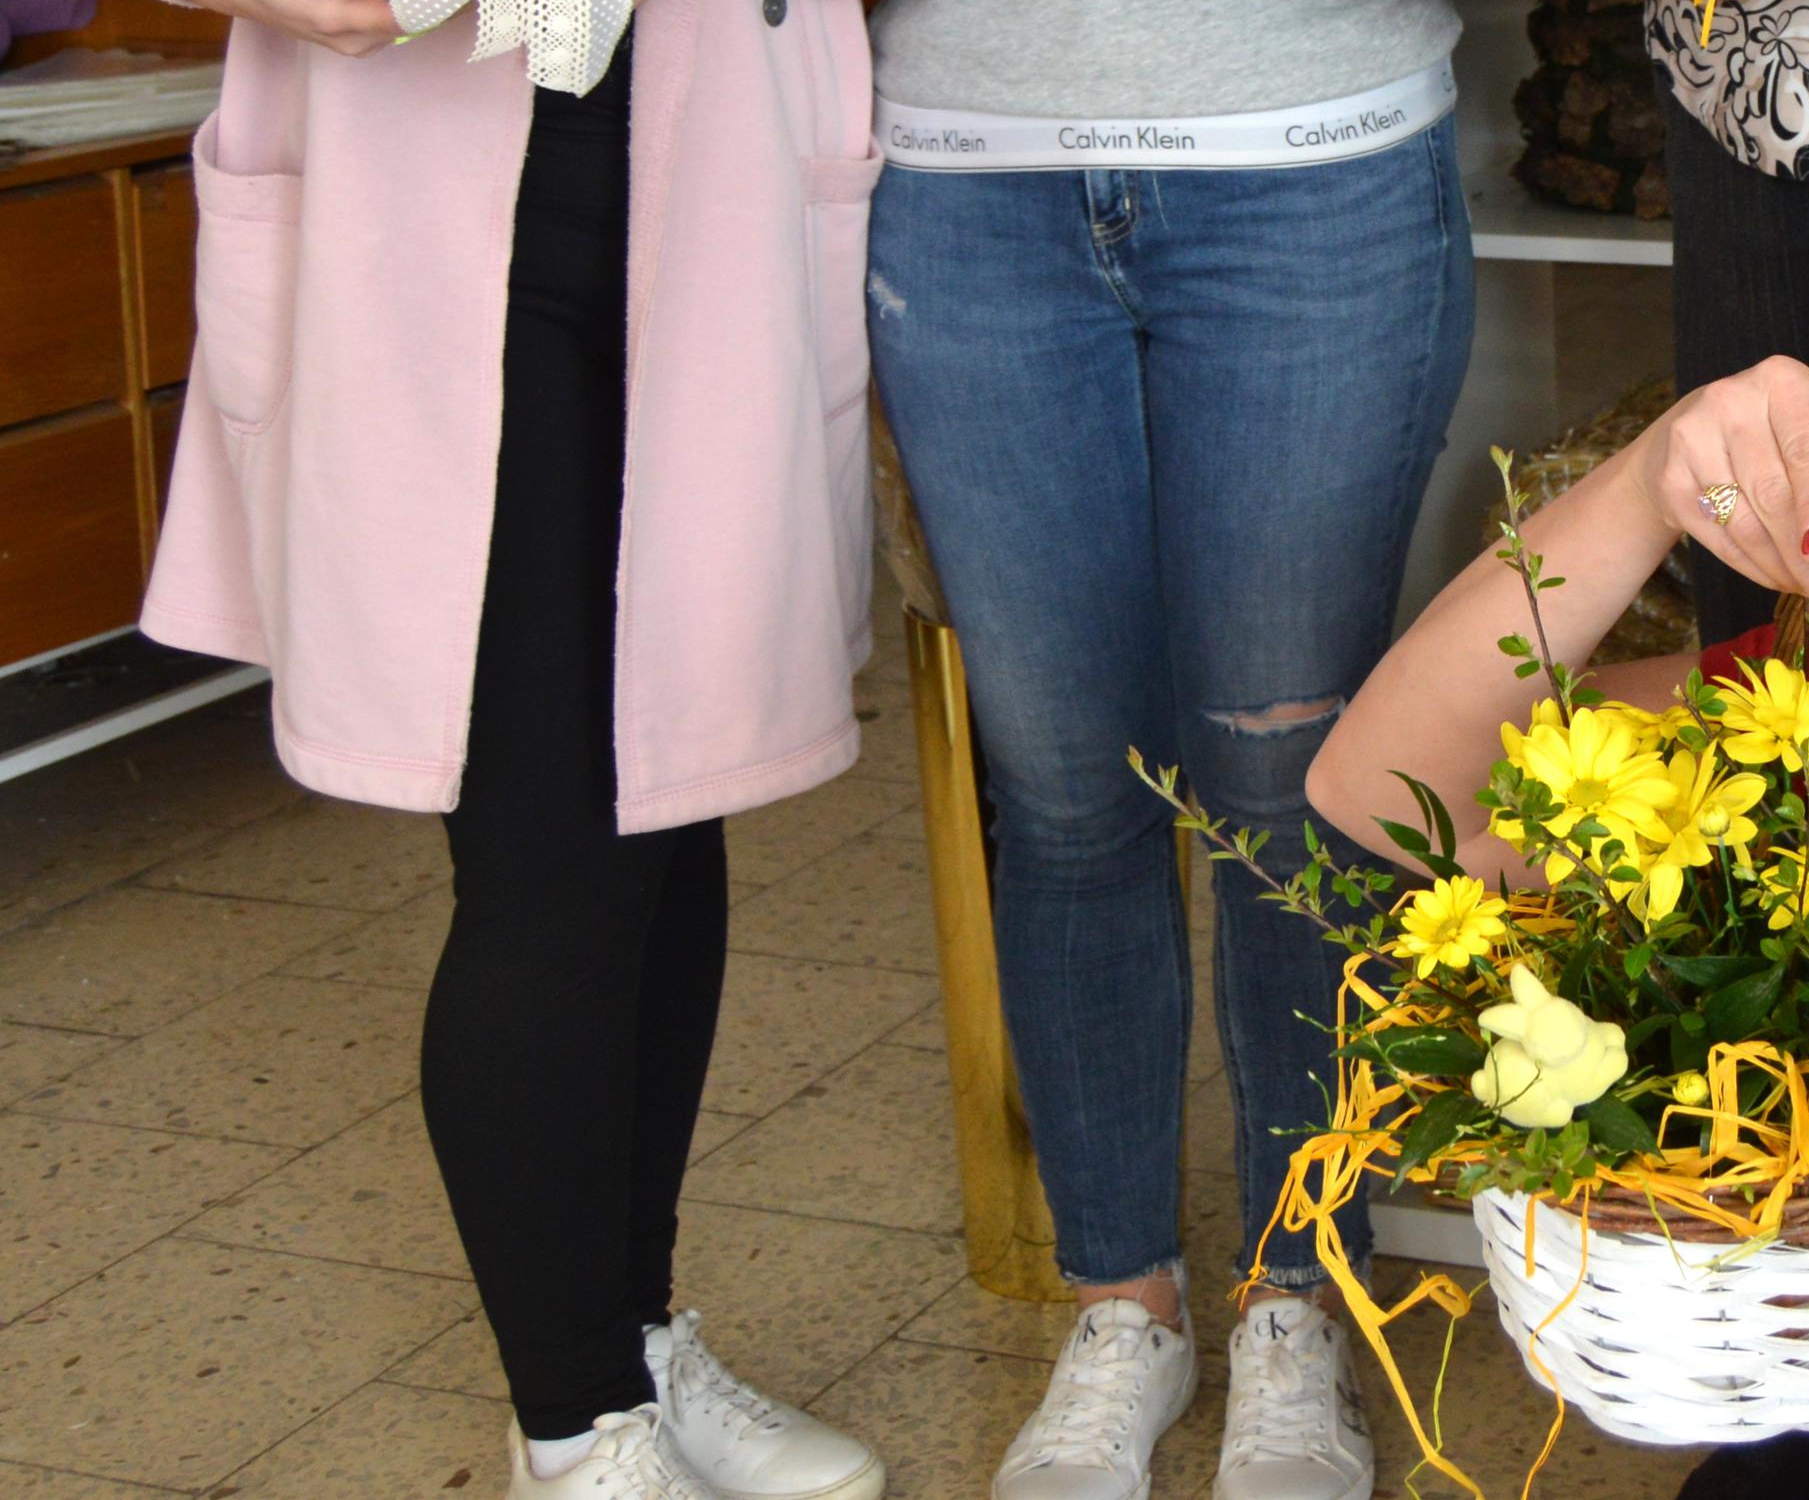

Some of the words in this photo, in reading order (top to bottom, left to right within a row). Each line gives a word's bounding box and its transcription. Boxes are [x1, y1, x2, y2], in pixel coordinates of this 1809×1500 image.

[891, 125, 939, 151] Calvin
[943, 128, 985, 152] Klein
[1058, 126, 1132, 150] Calvin
[1137, 126, 1195, 150] Klein
[1285, 118, 1358, 147] Calvin
[1359, 104, 1407, 135] Klein
